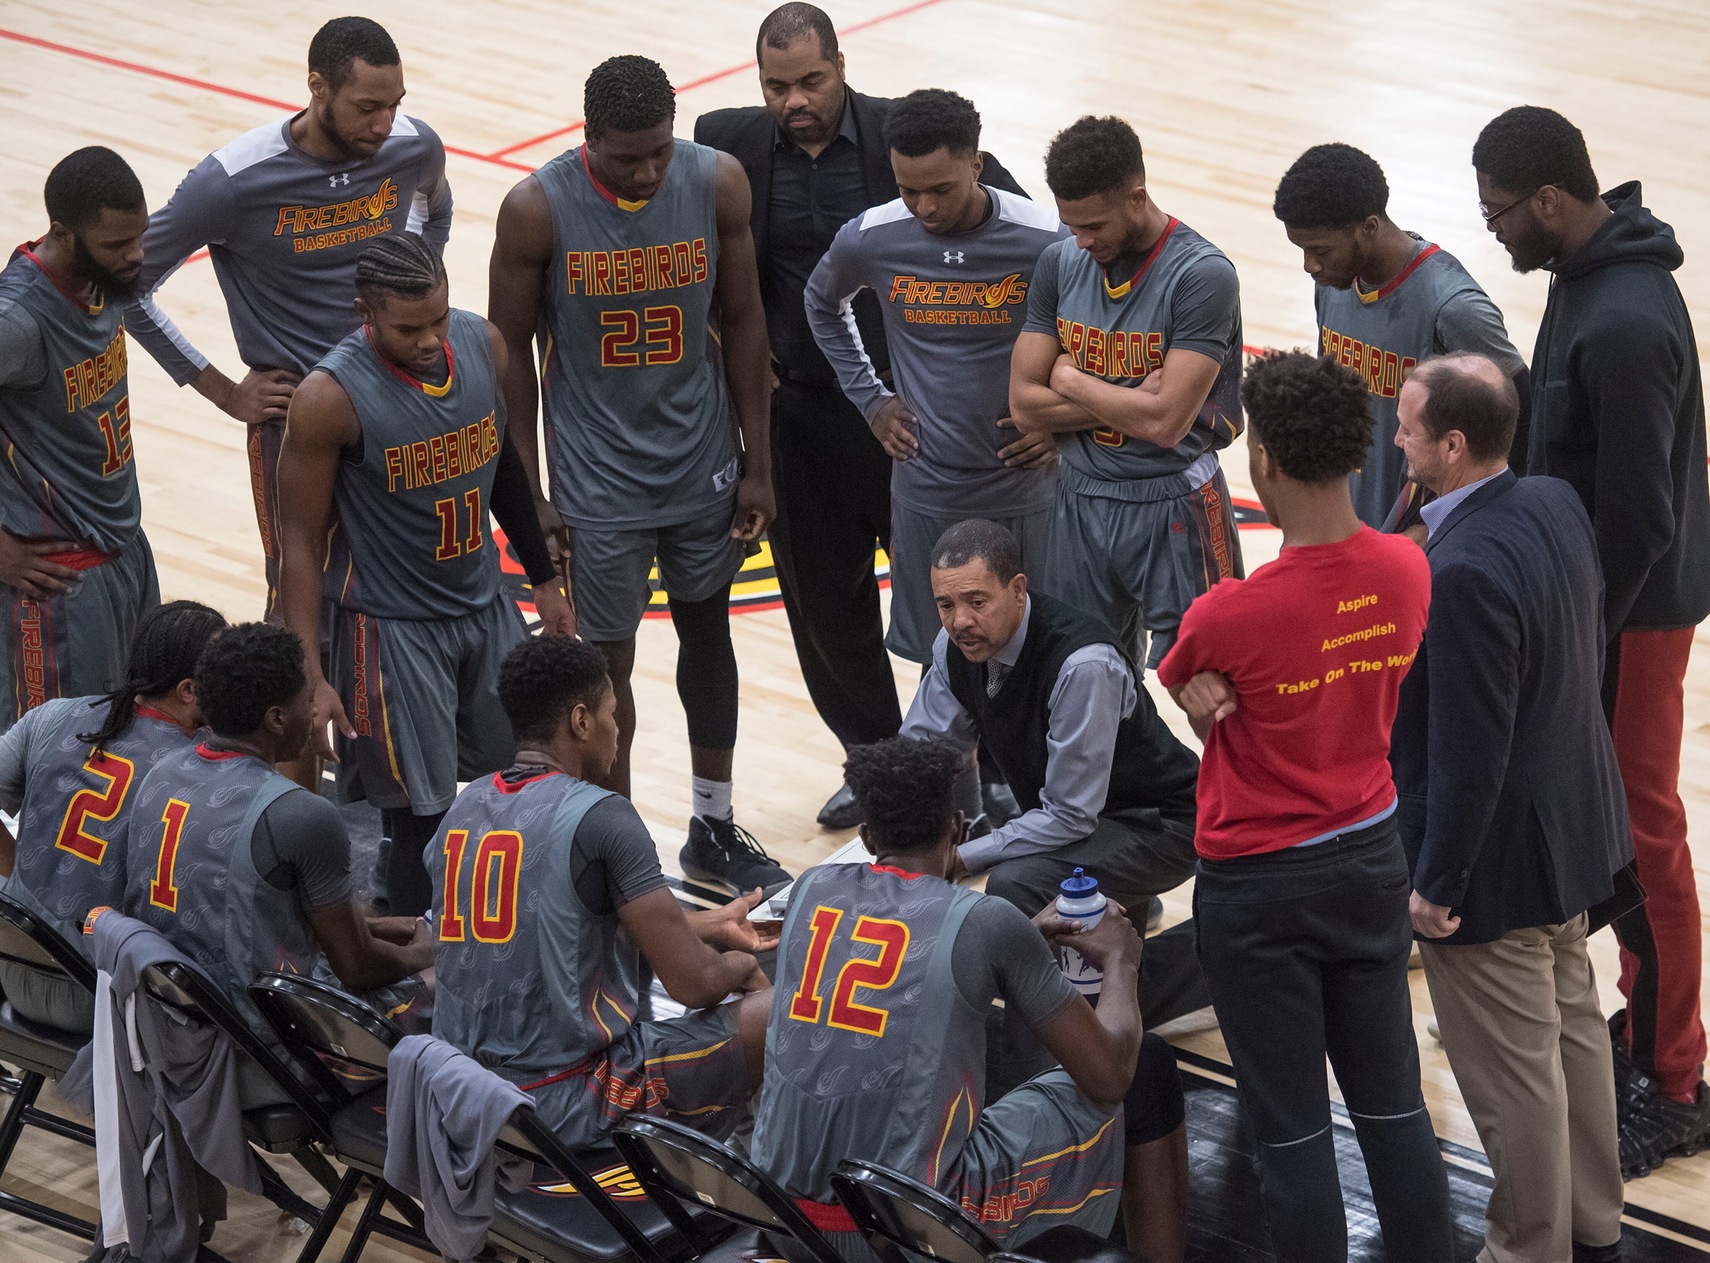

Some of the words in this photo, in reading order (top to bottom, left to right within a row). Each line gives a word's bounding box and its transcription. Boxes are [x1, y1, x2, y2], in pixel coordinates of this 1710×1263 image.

[273, 177, 398, 236] FIREBIRDS
[294, 217, 392, 253] BASKETBALL
[567, 237, 707, 296] FIREBIRDS
[889, 273, 1028, 309] FIREBIRDS
[601, 305, 683, 367] 23
[905, 309, 1012, 325] BASKETBALL
[64, 324, 128, 413] FIREBIR
[98, 394, 132, 477] 13
[385, 409, 499, 492] FIREBIRDS
[435, 487, 483, 561] 11
[1321, 622, 1396, 652] Accomplish
[1337, 594, 1378, 614] Aspire
[21, 600, 45, 710] FIREBIR
[1276, 679, 1319, 694] Take
[1325, 668, 1344, 683] On
[1349, 660, 1382, 673] The
[55, 746, 134, 866] 2
[150, 797, 191, 913] 1
[439, 829, 524, 944] 10
[788, 905, 911, 1038] 12
